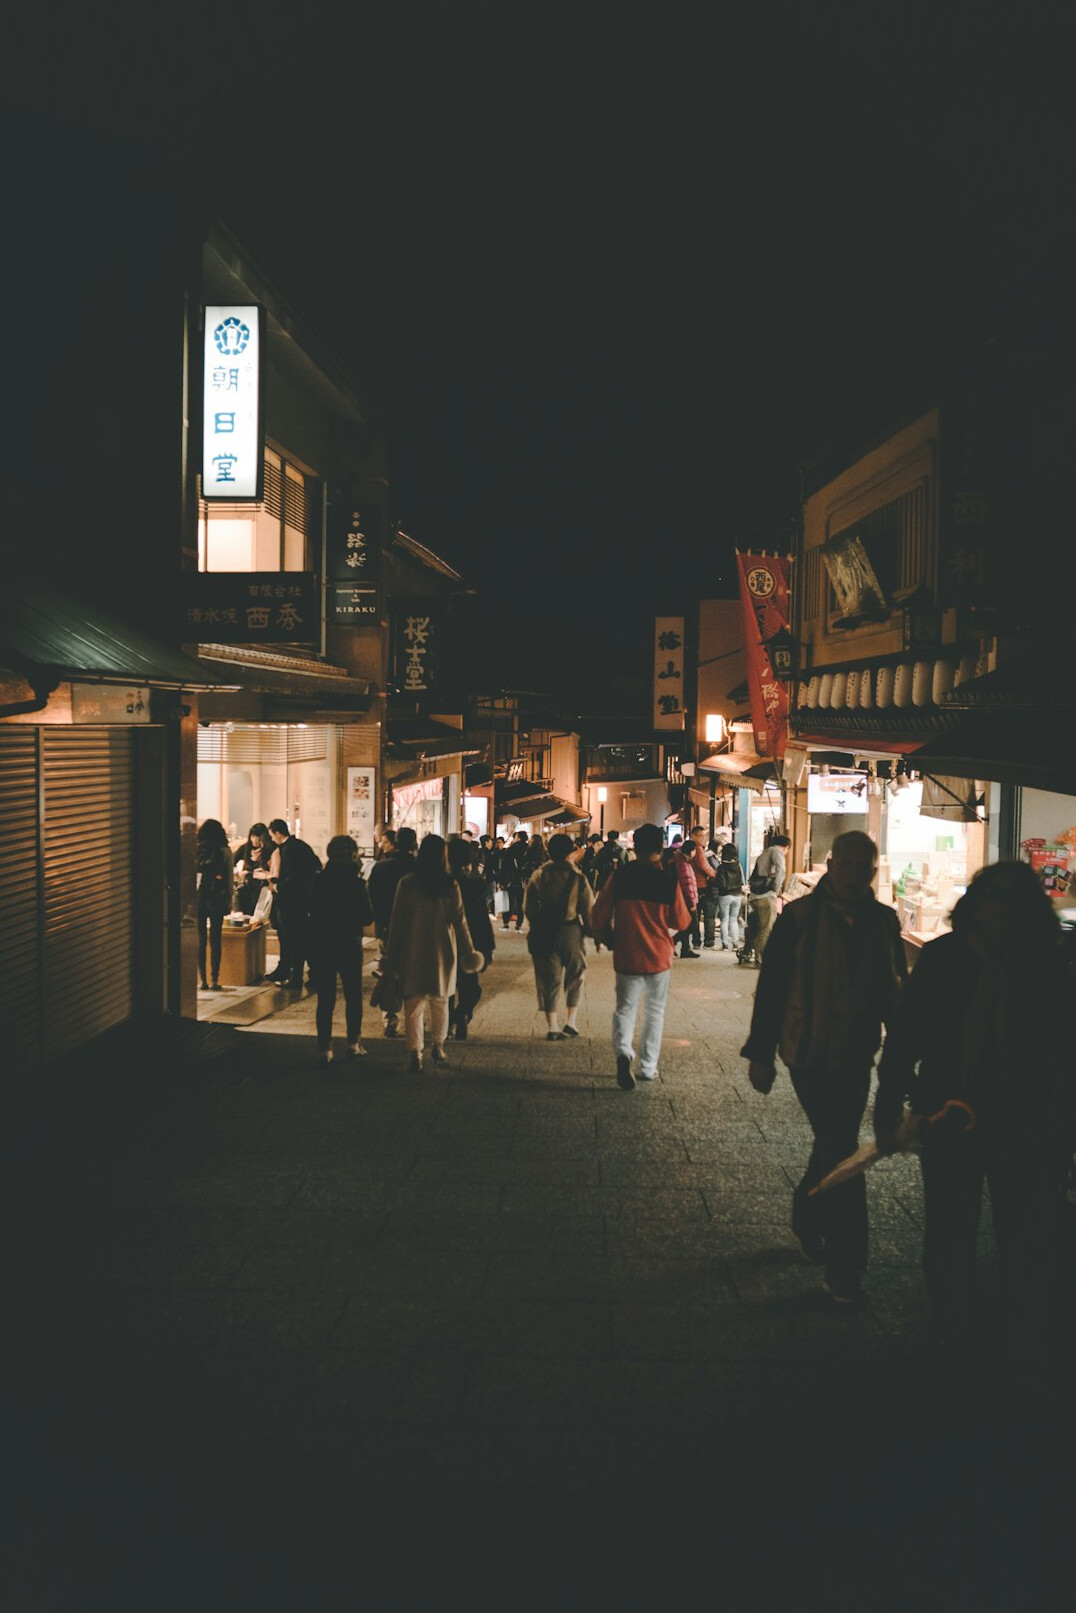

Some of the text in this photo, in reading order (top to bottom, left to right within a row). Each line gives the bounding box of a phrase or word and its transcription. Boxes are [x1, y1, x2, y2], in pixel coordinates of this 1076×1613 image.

[212, 365, 240, 483] 朝日堂
[247, 584, 302, 597] 有限会社
[245, 602, 304, 630] 西秀
